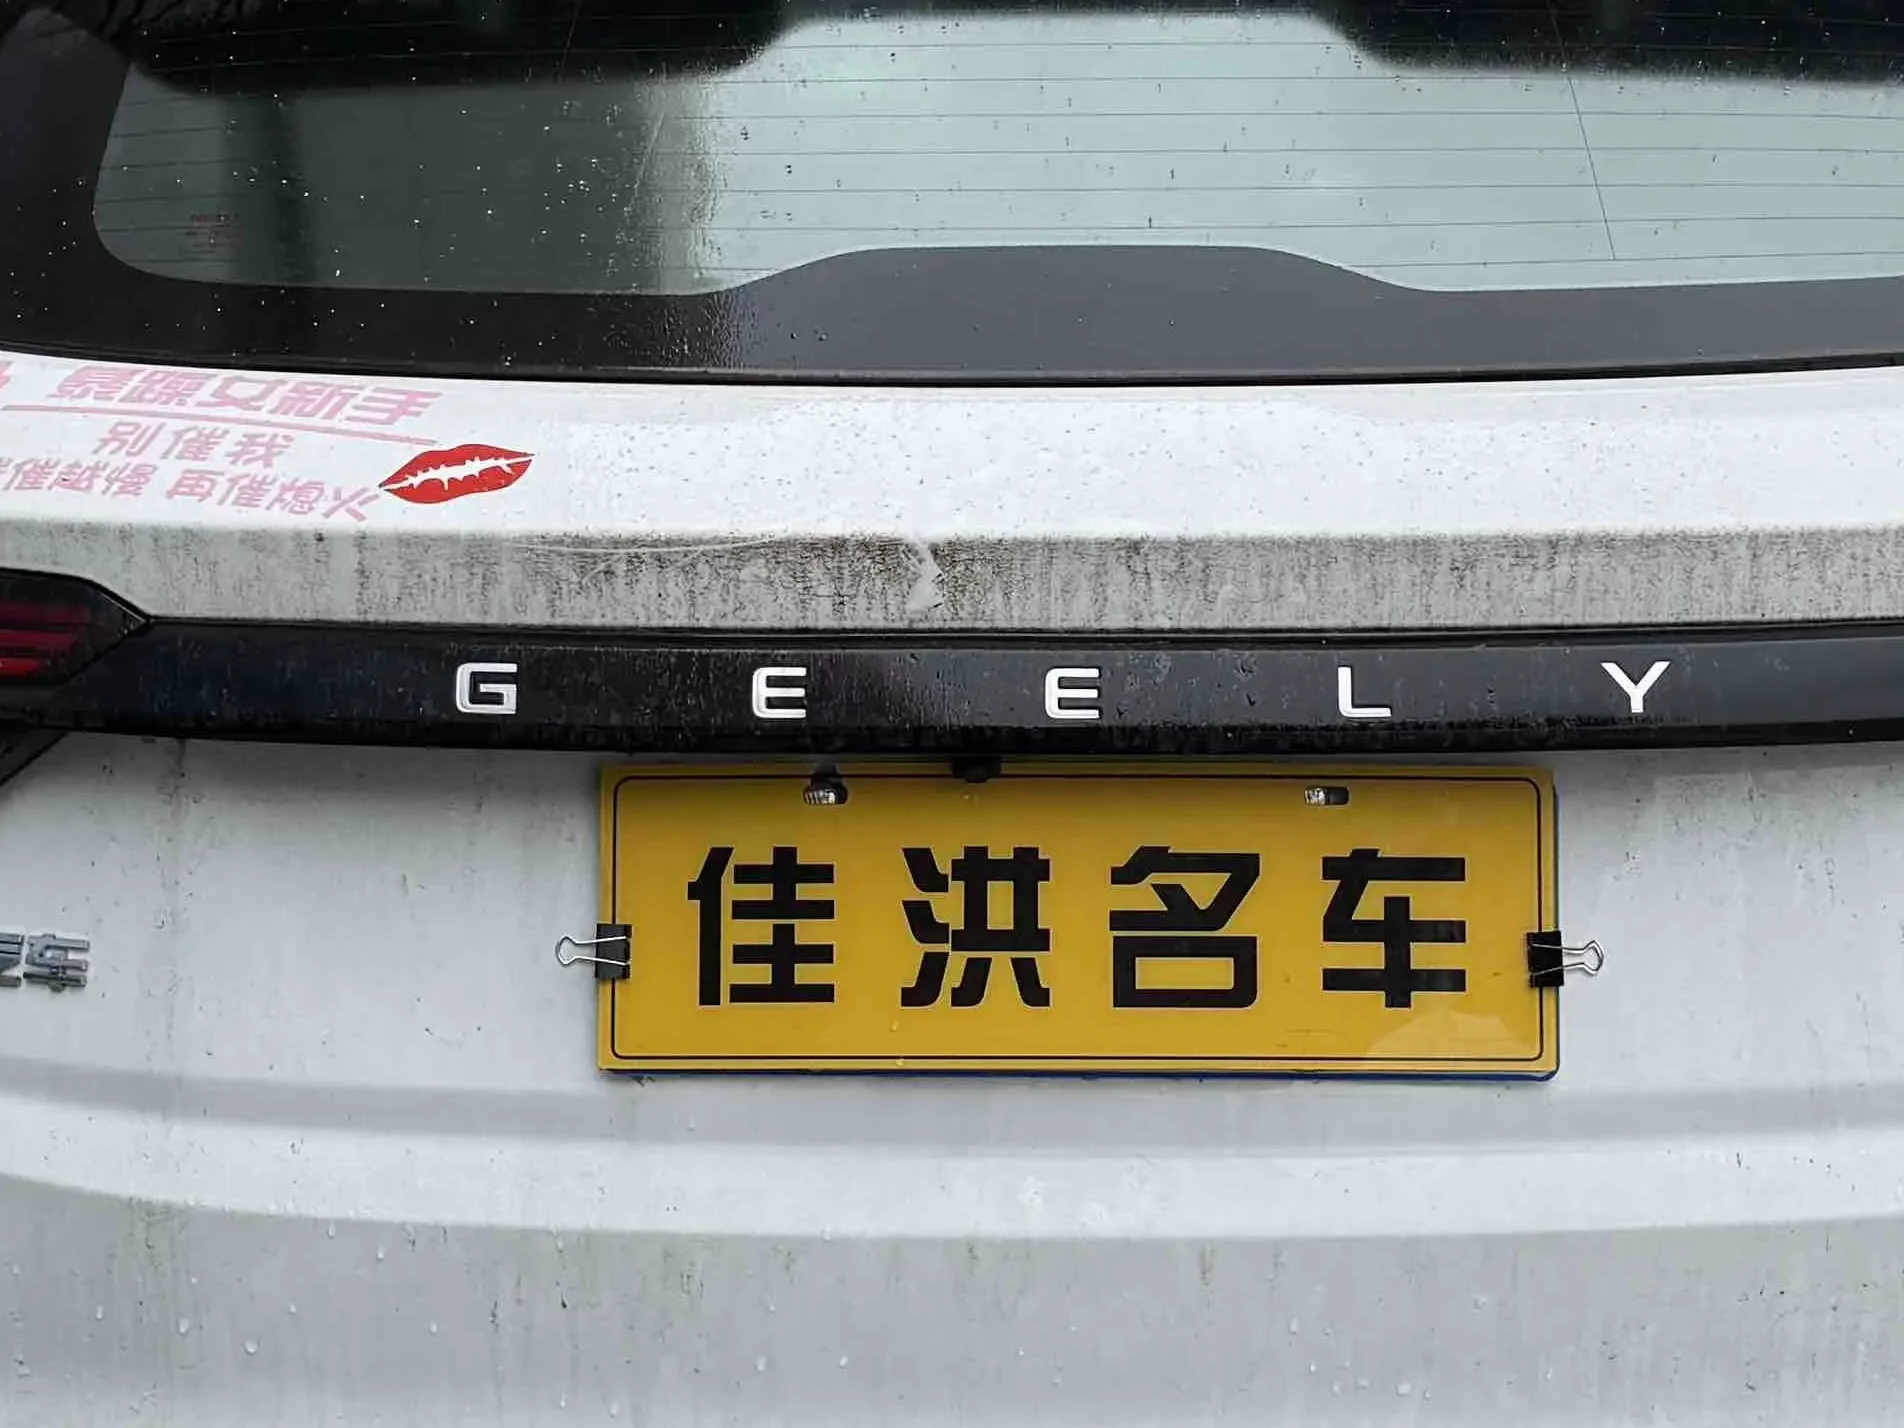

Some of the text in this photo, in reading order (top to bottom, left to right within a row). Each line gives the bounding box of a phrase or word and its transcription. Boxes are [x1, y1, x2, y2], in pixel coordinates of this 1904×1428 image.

[45, 363, 444, 428] 暴躁女新手
[94, 419, 296, 470] 别催我
[164, 474, 382, 523] 再催熄火
[454, 659, 1672, 720] GEELY
[686, 844, 1468, 1010] 佳洪名车
